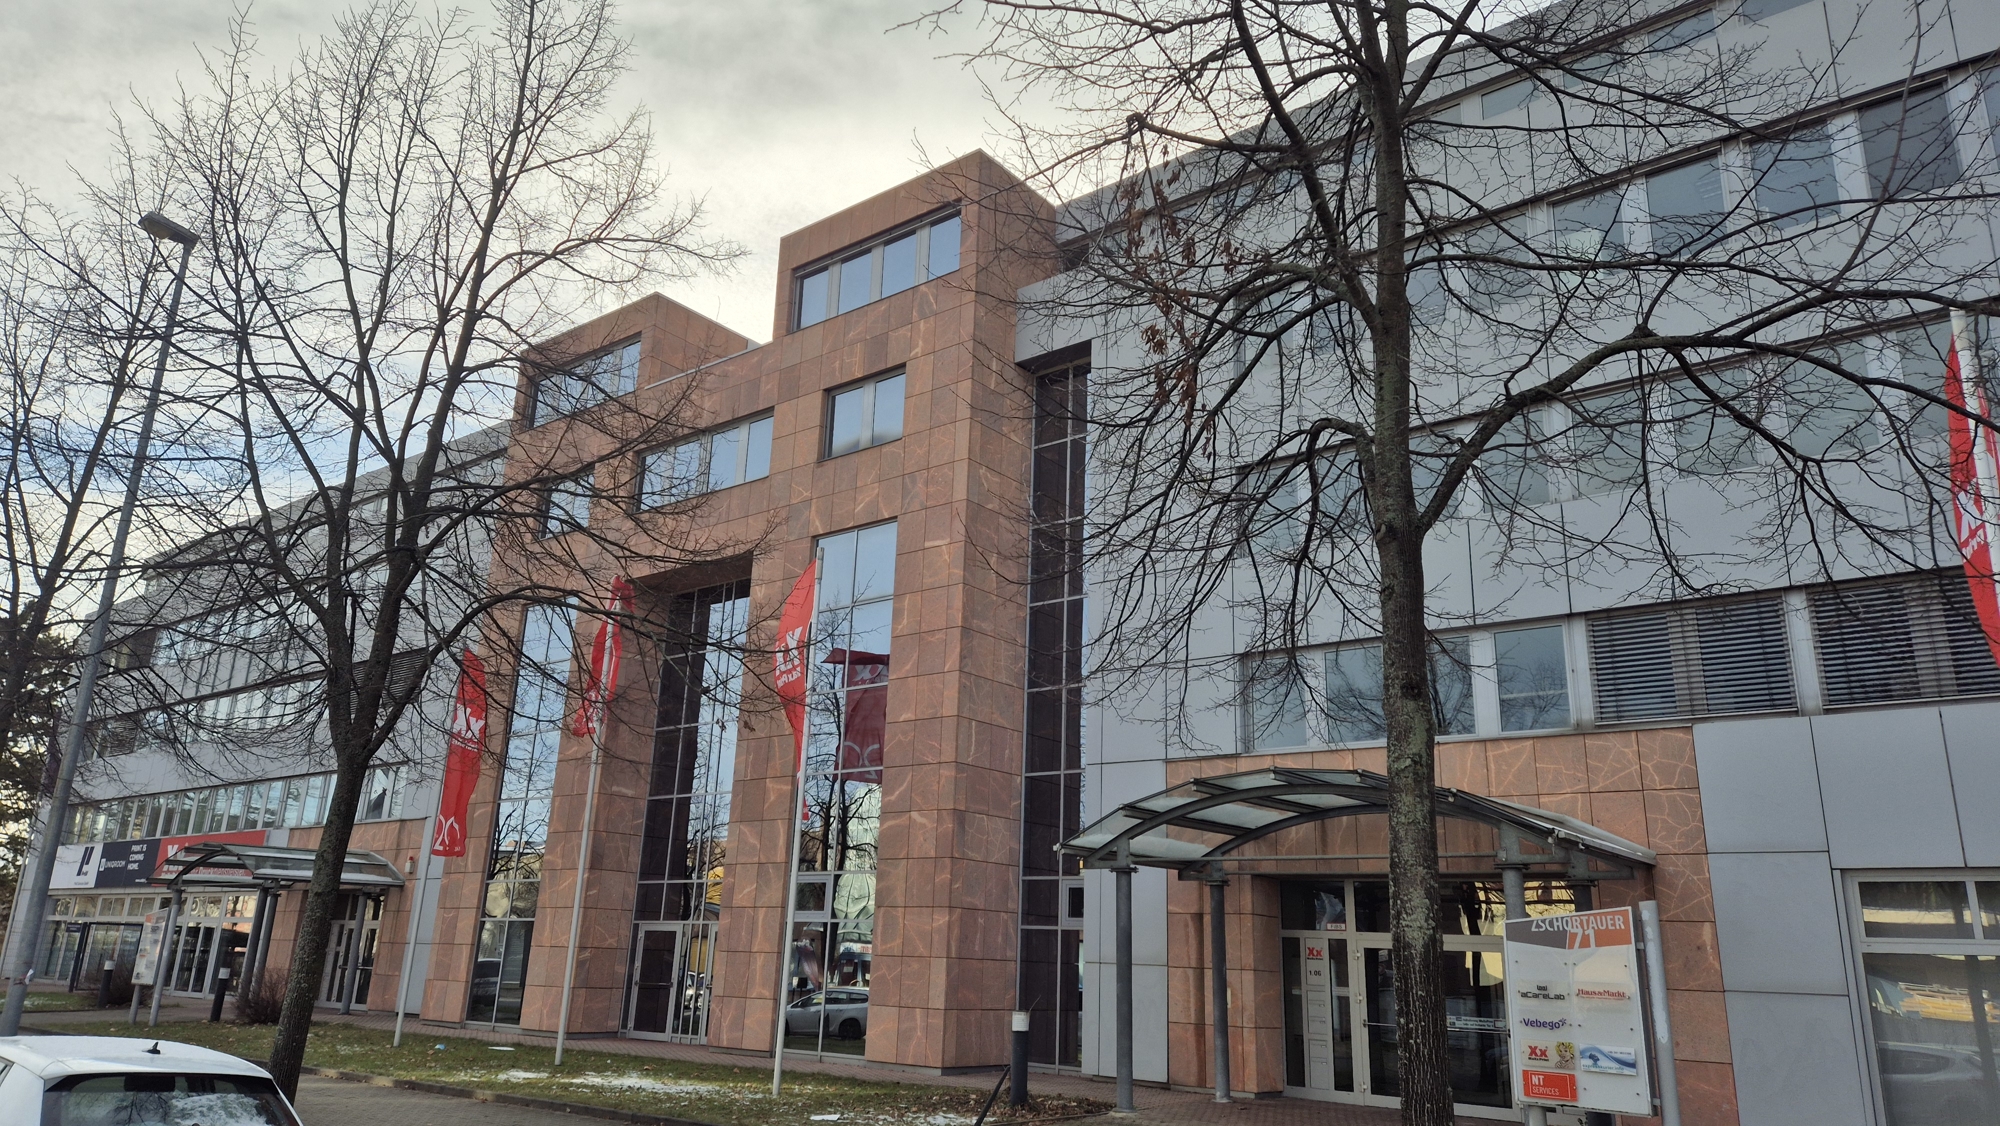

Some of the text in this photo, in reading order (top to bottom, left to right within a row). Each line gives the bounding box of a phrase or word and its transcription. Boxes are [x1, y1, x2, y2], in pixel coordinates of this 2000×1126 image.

[1531, 915, 1625, 932] ZSCHORTAUER
[1569, 928, 1596, 949] 71
[1522, 1018, 1561, 1030] Vebego
[1531, 1075, 1545, 1085] NT
[1532, 1086, 1560, 1096] SERVICES
